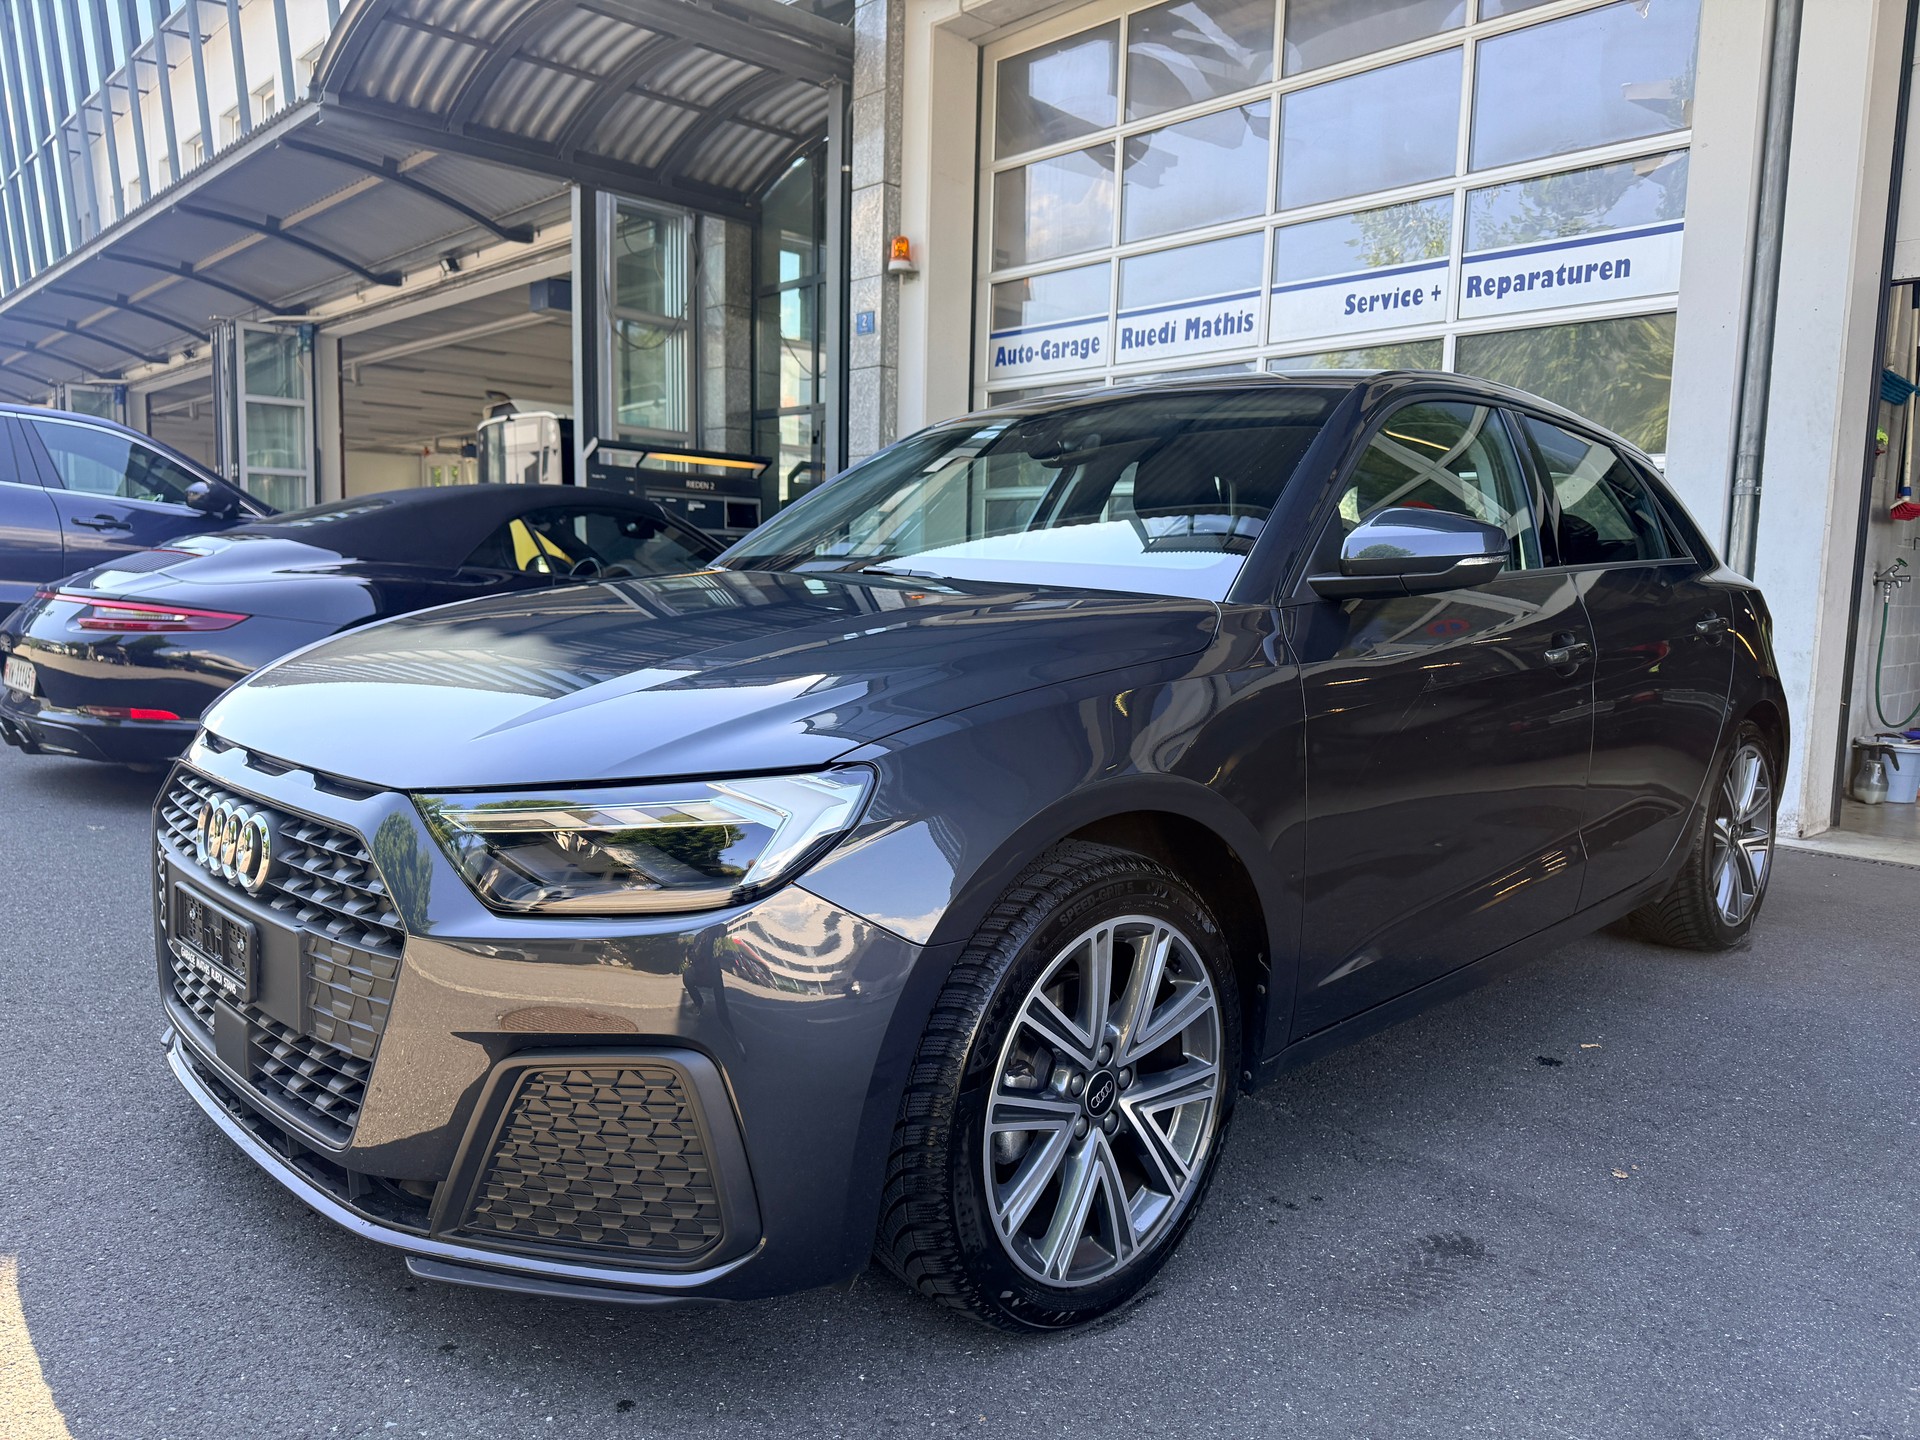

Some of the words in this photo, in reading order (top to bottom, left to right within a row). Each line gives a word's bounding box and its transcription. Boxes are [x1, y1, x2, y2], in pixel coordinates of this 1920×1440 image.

[1344, 287, 1423, 315] Service
[1431, 285, 1441, 301] +
[1466, 258, 1631, 300] Reparaturen
[994, 336, 1100, 367] Auto-Garage
[1121, 320, 1177, 350] Ruedi
[1184, 310, 1254, 341] Mathis
